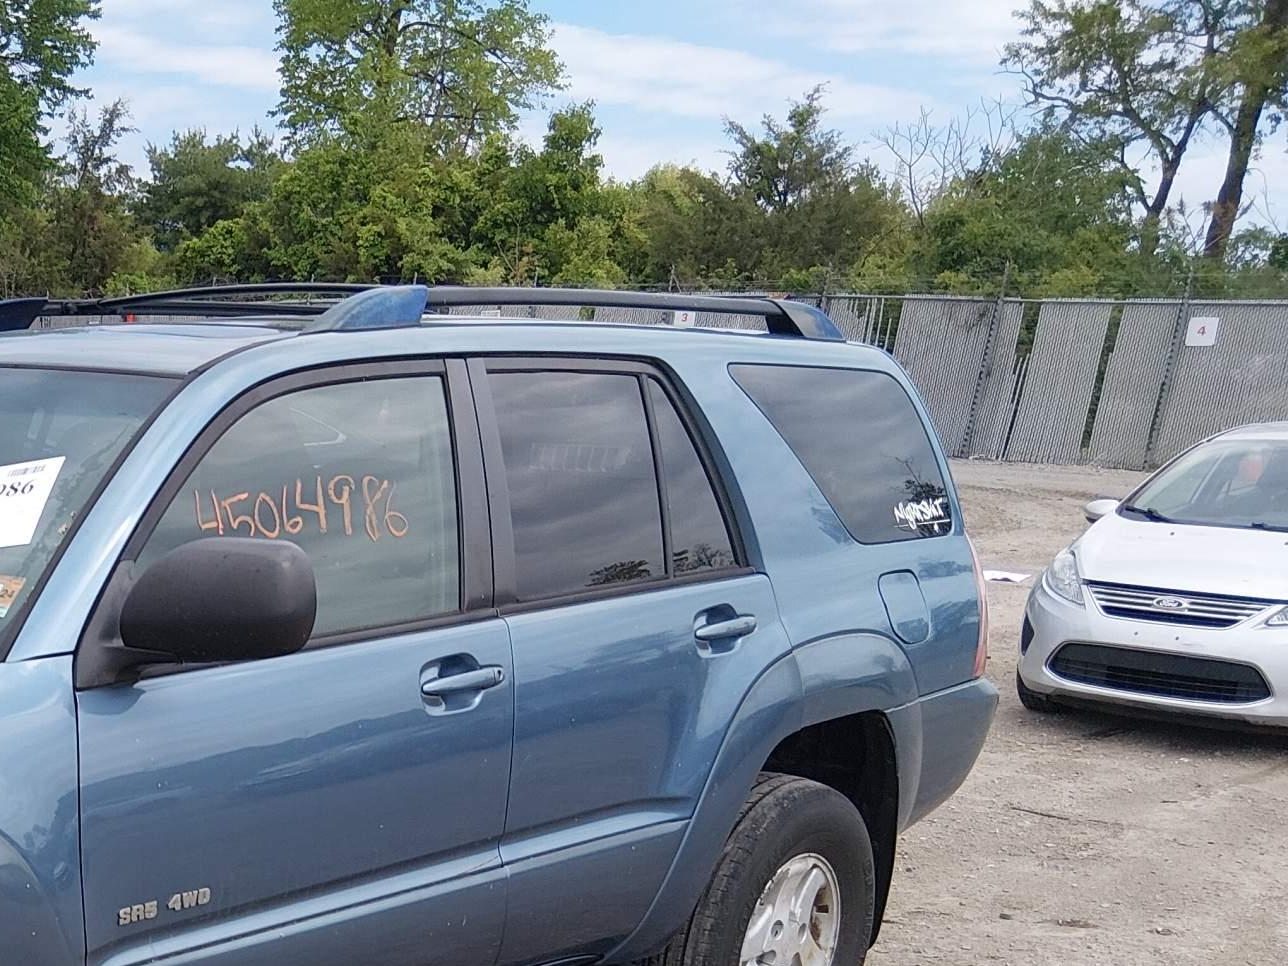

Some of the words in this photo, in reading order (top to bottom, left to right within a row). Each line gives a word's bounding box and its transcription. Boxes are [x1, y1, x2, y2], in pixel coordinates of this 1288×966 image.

[681, 312, 689, 322] 3
[1197, 325, 1207, 336] 4
[194, 475, 409, 542] 45064986
[118, 900, 158, 926] SR5
[167, 887, 211, 912] 4WD
